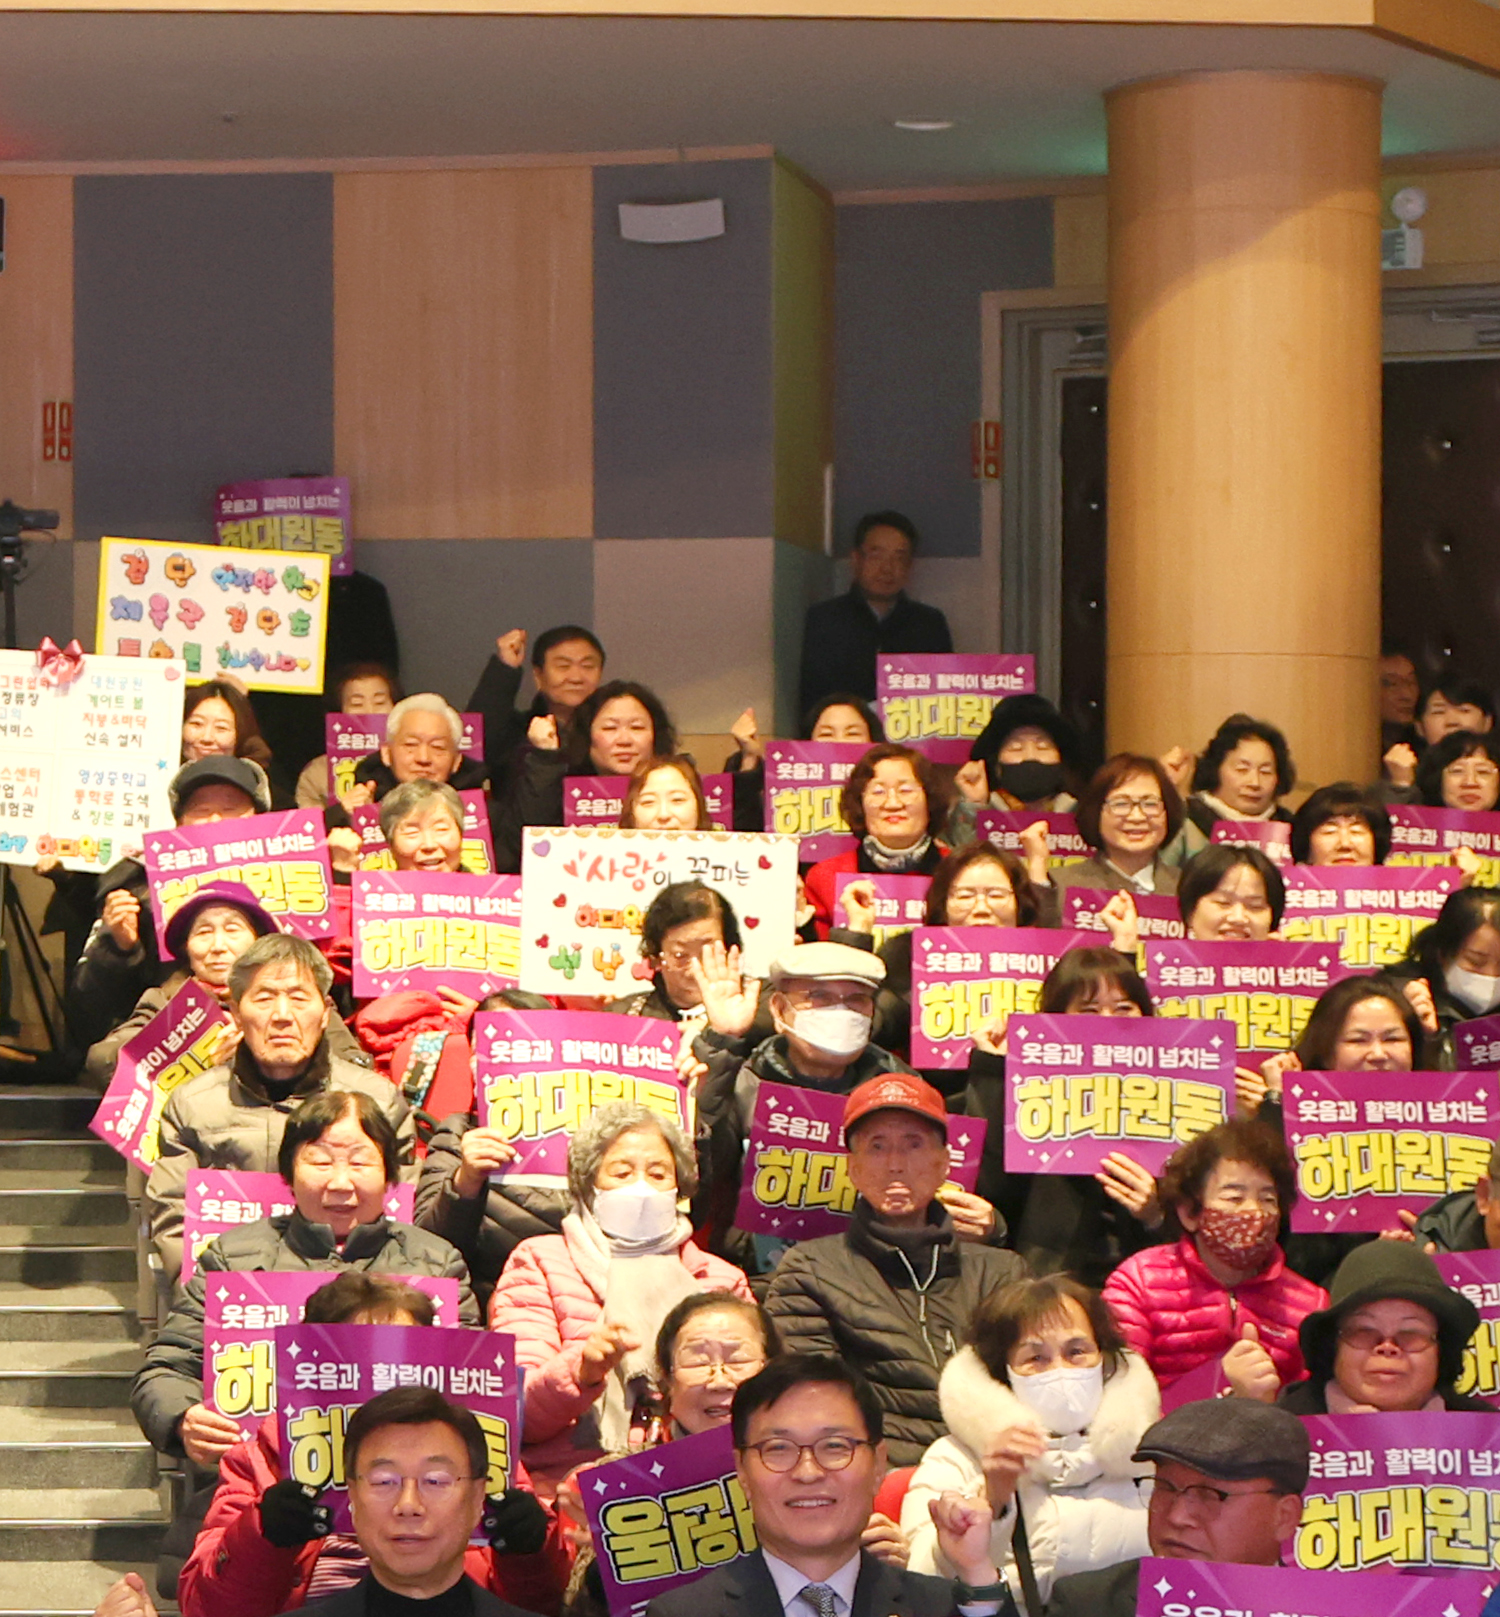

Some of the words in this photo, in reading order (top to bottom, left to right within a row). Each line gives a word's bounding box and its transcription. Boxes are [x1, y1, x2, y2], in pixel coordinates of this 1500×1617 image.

[22, 784, 39, 798] AI
[157, 848, 208, 872] 웃음과
[214, 840, 264, 864] 활력이
[265, 833, 315, 855] 넘치는
[1021, 1042, 1083, 1066] 웃음과
[1092, 1043, 1154, 1068] 활력이
[1158, 1044, 1221, 1070] 넘치는
[1013, 1072, 1227, 1144] 하대원동
